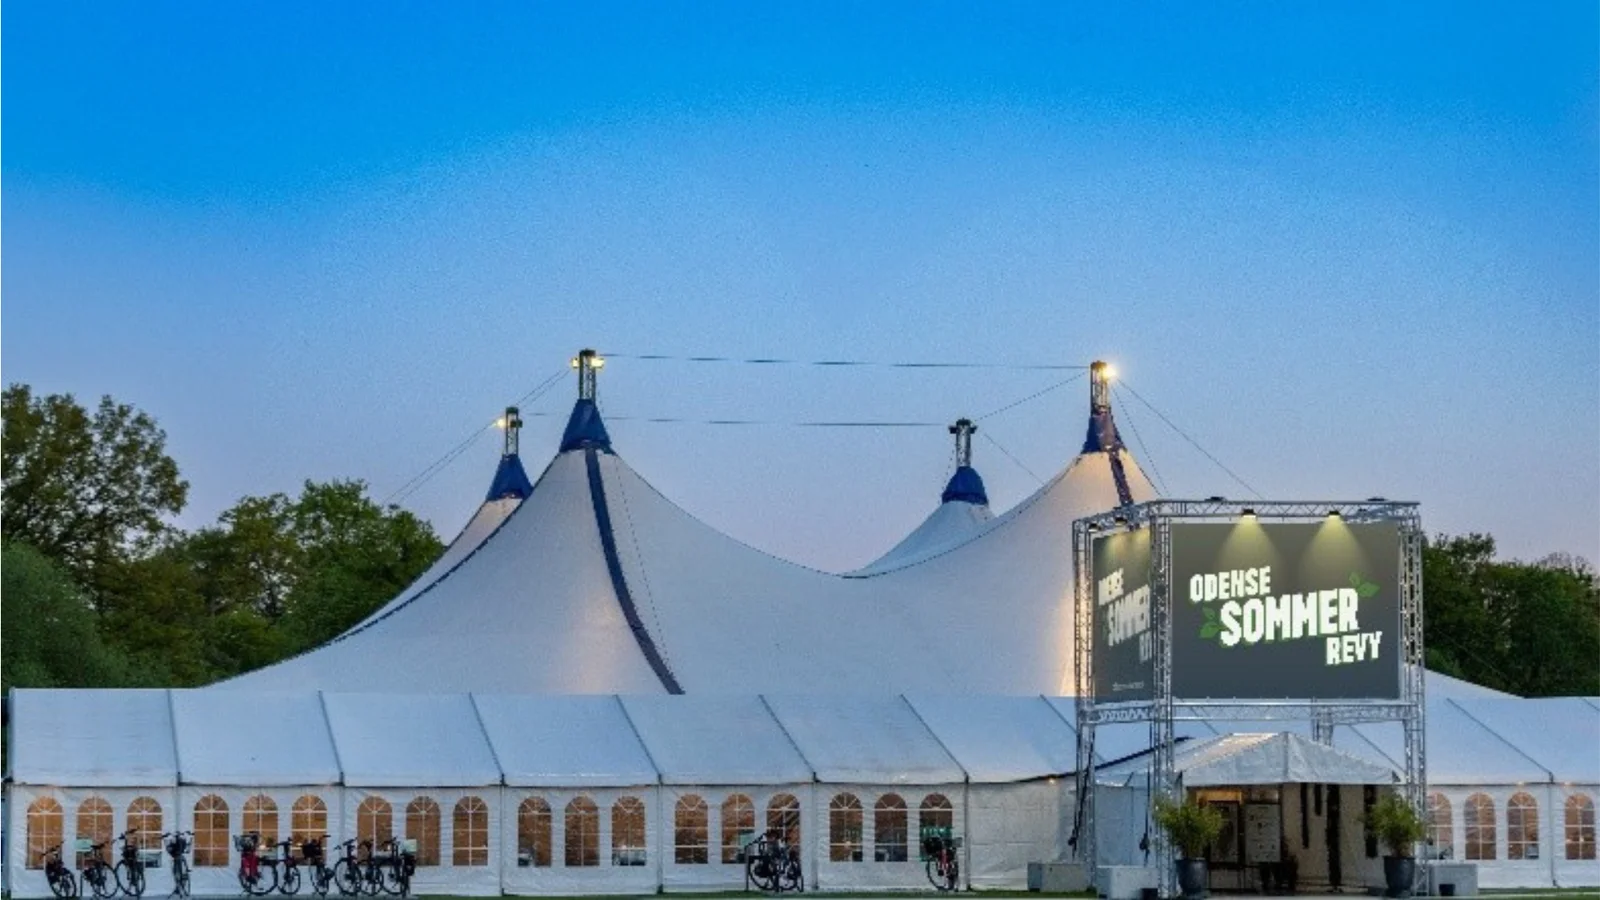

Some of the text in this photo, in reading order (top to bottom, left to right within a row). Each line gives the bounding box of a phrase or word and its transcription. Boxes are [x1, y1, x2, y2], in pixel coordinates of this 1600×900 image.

[1189, 566, 1271, 603] ODENSE
[1220, 588, 1360, 647] SOMMER
[1326, 630, 1383, 665] REVY
